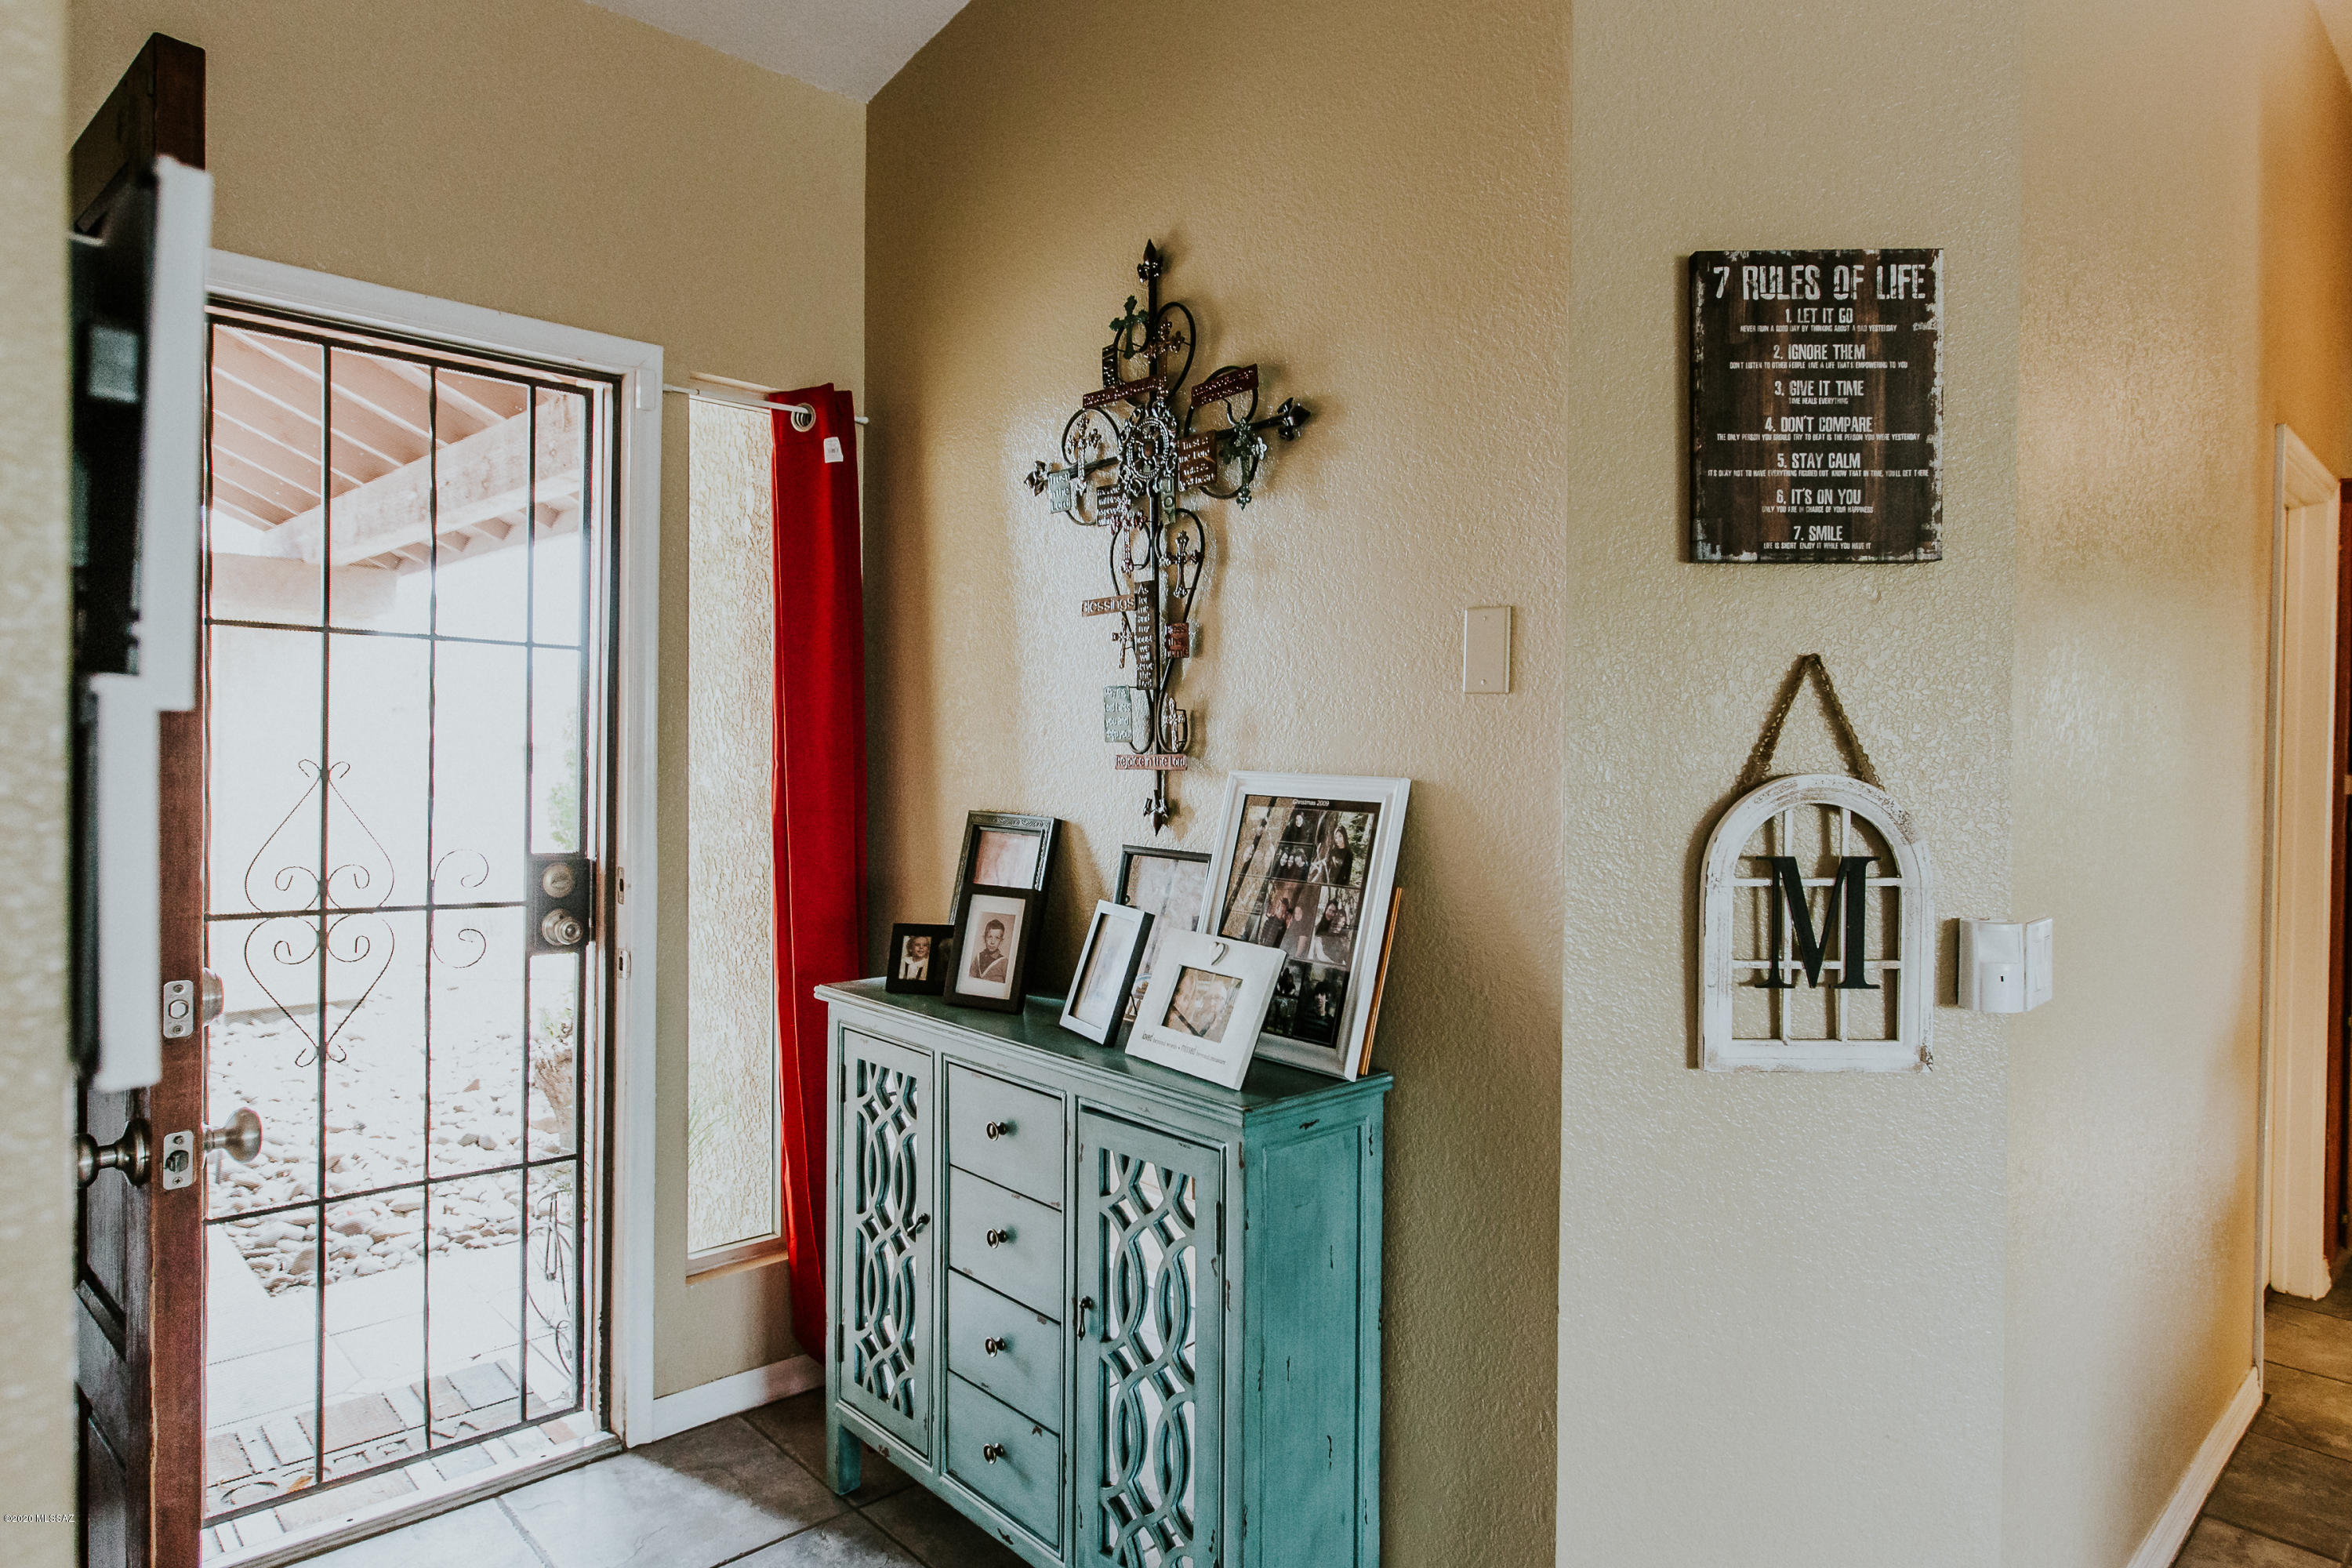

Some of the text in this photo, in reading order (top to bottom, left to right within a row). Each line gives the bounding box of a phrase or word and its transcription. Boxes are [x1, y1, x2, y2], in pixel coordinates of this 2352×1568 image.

[1713, 264, 1926, 300] 7 RULES OF LIFE
[1785, 307, 1853, 323] 1. LET IT GO
[1773, 344, 1865, 360] 2. IGNORE THEM
[1775, 380, 1864, 396] 3. GIVE IT TIME
[1765, 416, 1873, 432] 4. DON'T COMPARE
[1777, 452, 1860, 468] 5. STAY CALM
[1777, 488, 1861, 504] 6. IT'S ON YOU
[1794, 525, 1842, 541] 7. SMILE
[1138, 584, 1149, 594] As
[1082, 596, 1134, 614] Blessings
[1755, 855, 1881, 989] M
